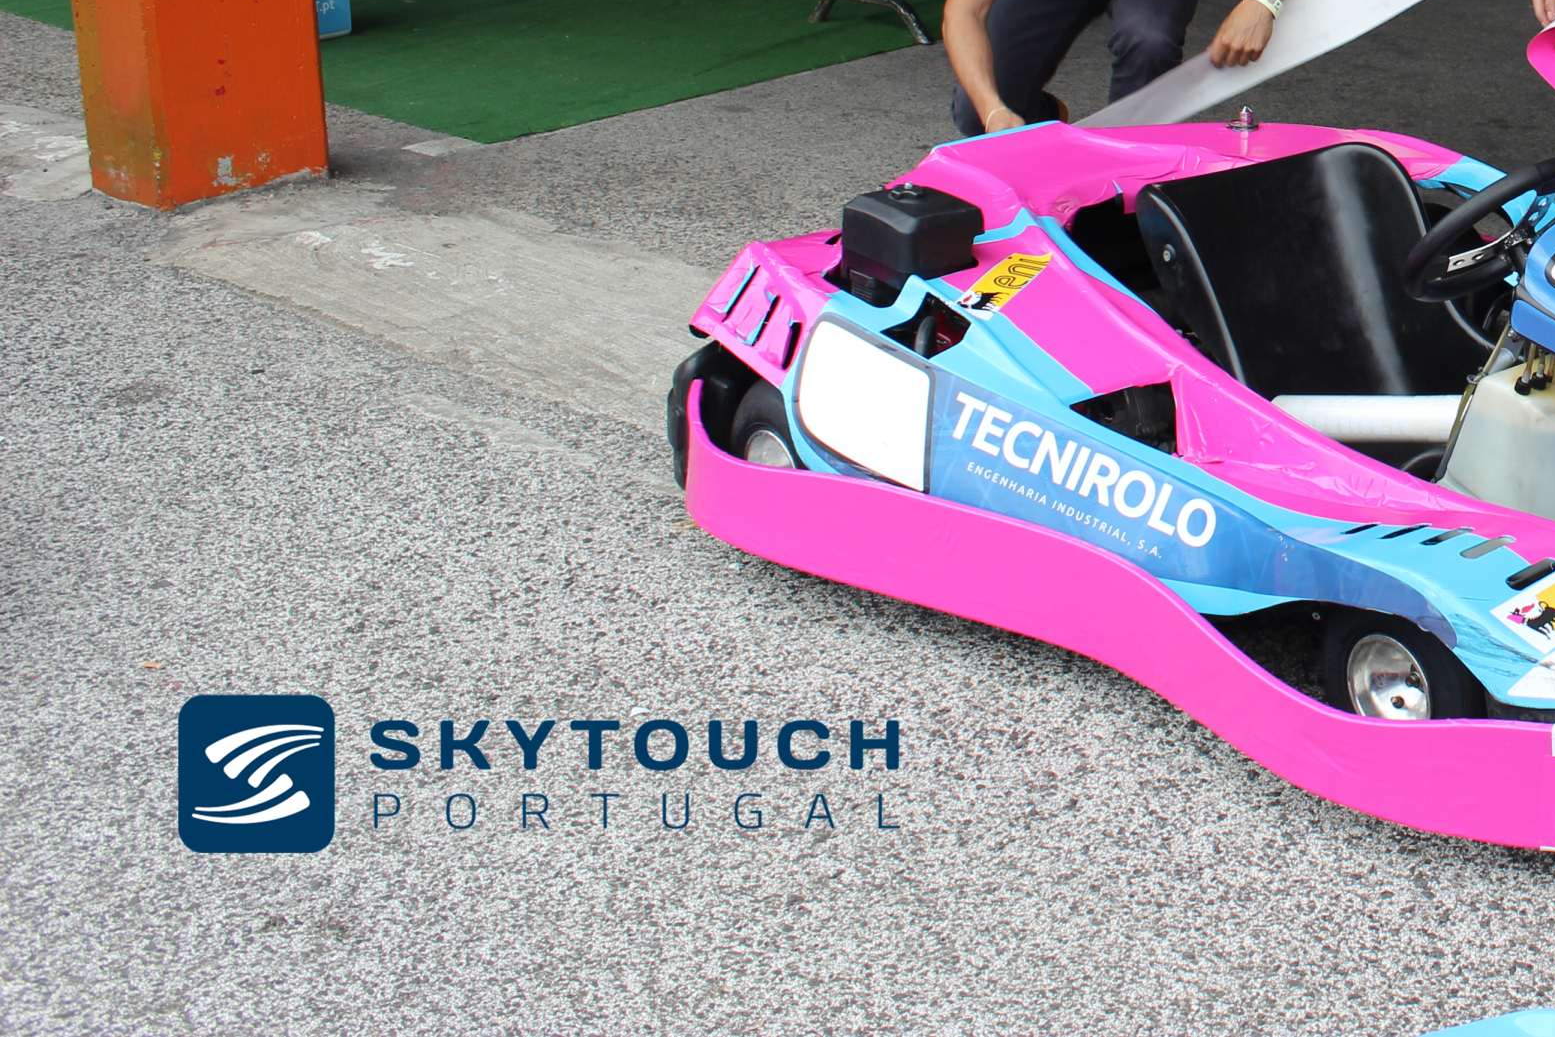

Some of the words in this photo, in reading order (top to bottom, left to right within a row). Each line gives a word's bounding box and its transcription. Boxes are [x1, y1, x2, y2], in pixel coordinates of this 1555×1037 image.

[951, 391, 1217, 548] TECNIROLO
[966, 461, 1048, 507] ENGENHARIA
[1051, 500, 1132, 547] INDUSTRIAL,
[1137, 539, 1163, 559] S.A.
